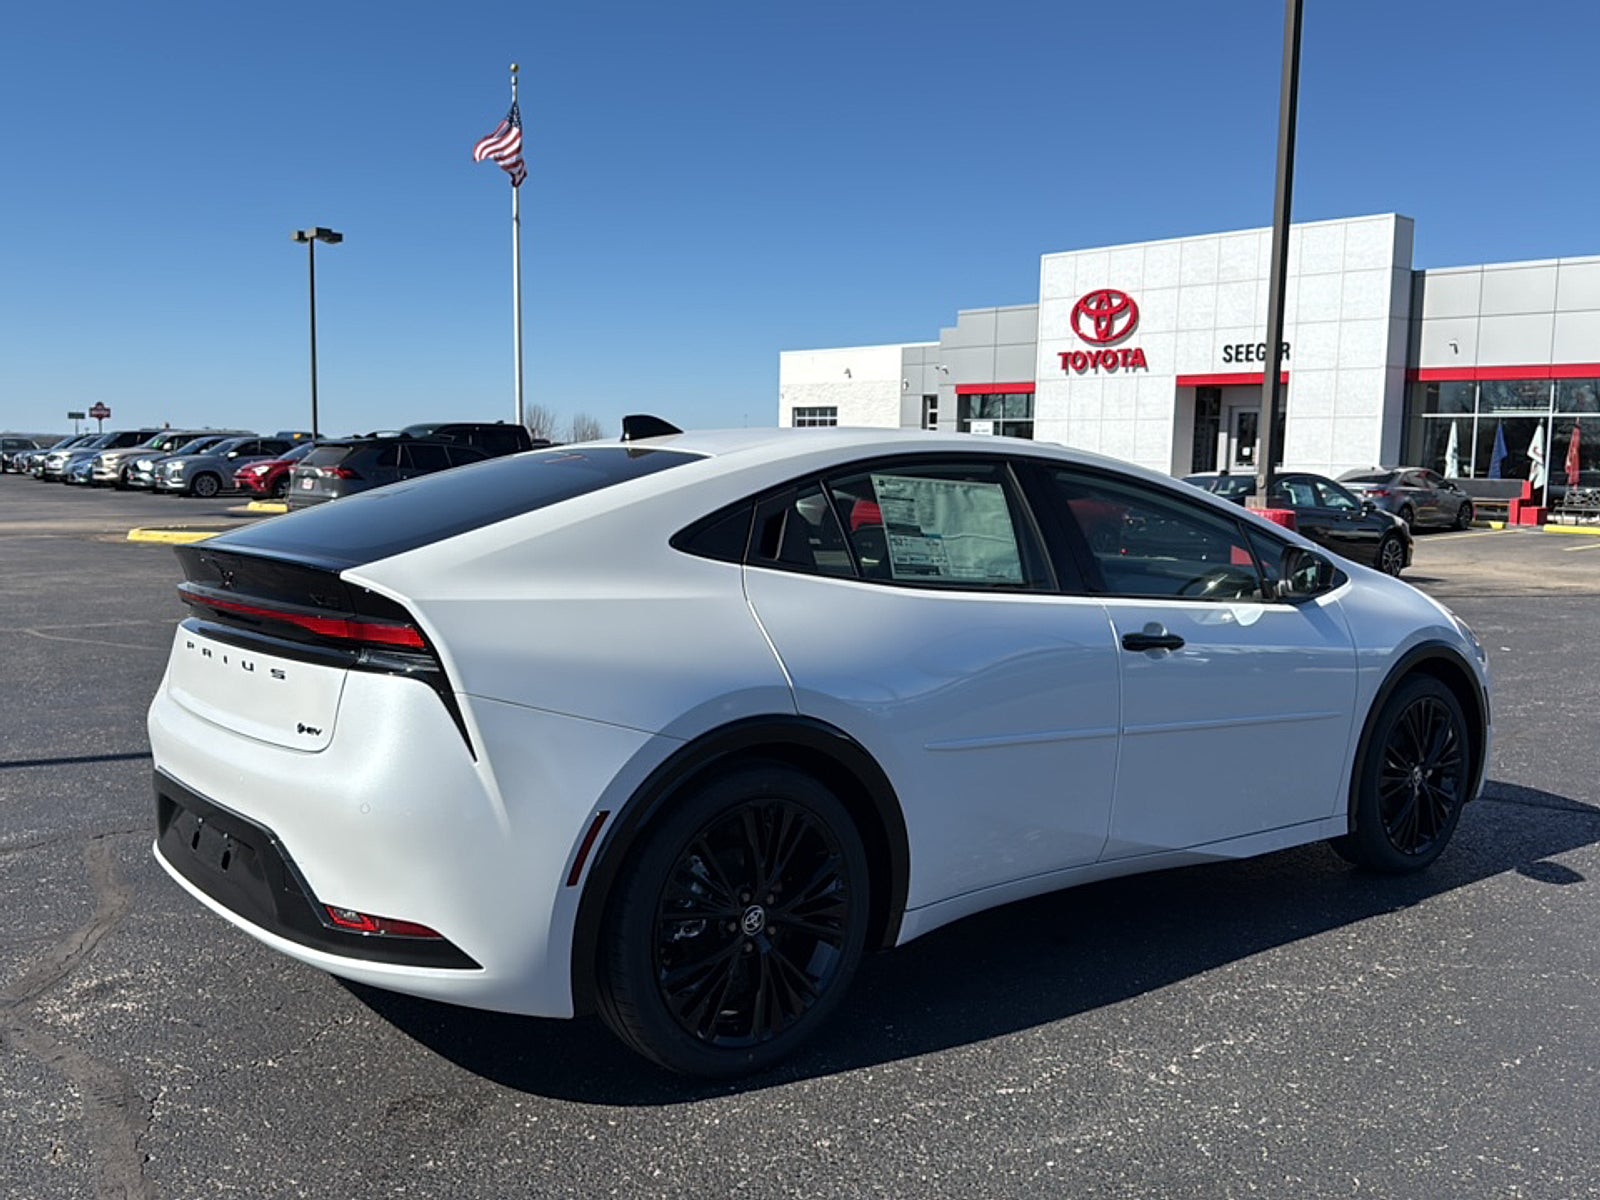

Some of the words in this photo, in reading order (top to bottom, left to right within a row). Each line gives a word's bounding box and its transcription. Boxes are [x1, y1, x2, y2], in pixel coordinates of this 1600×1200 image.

[1057, 347, 1148, 374] TOYOTA
[1222, 342, 1290, 363] SEEGR
[187, 641, 285, 680] PRIUS
